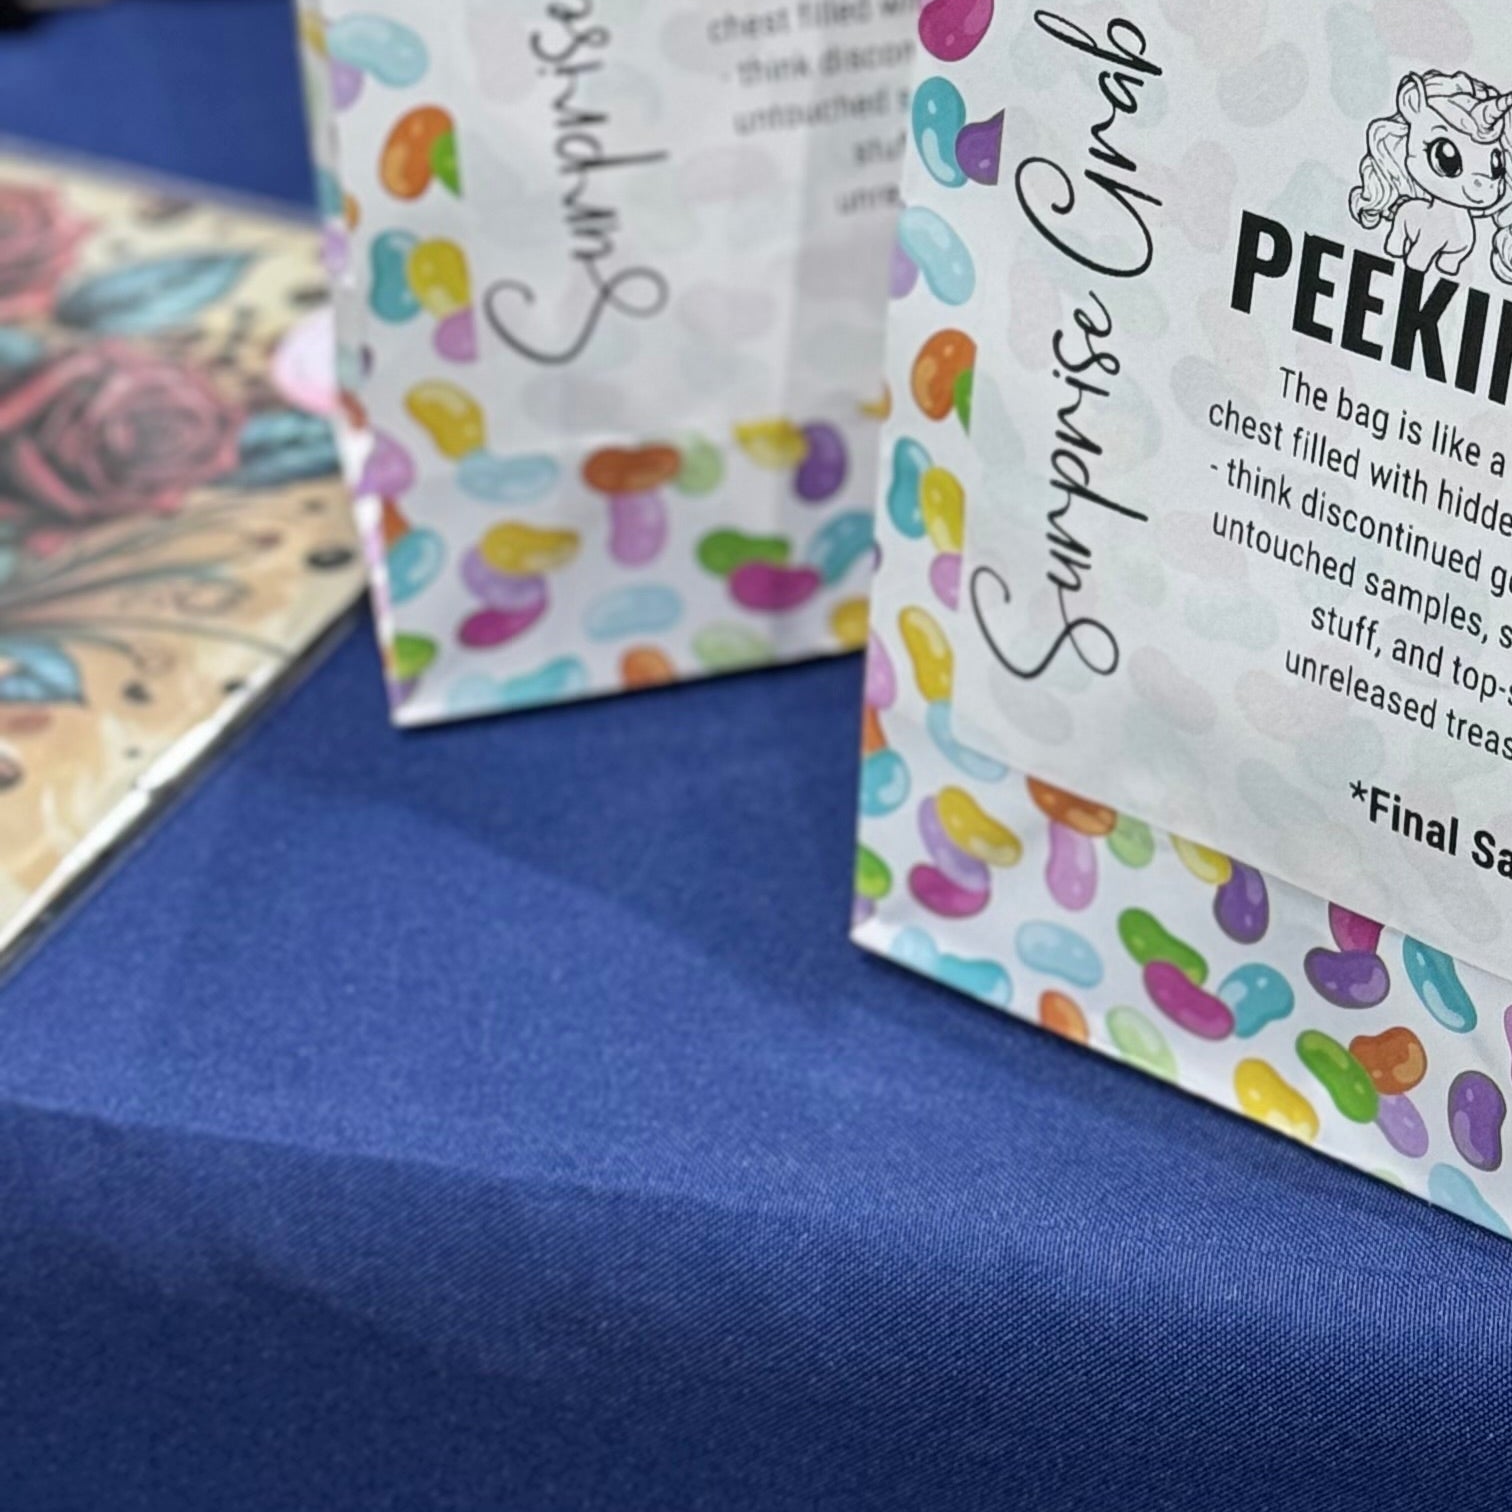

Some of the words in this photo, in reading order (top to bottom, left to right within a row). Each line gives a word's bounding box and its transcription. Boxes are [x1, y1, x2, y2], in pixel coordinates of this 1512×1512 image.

[1015, 8, 1165, 279] Grab
[1208, 399, 1284, 452] chest
[1292, 426, 1361, 481] filled
[1370, 461, 1429, 505] with
[1279, 366, 1328, 412] The
[1335, 386, 1390, 441] bag
[1398, 409, 1423, 446] is
[1431, 419, 1481, 468] like
[1489, 451, 1506, 479] a
[969, 290, 1149, 681] Surprise
[1226, 458, 1292, 510] think
[1301, 486, 1482, 582] discontinued
[1212, 511, 1357, 588] untouched
[1364, 571, 1488, 645] samples,
[1285, 649, 1438, 730] unreleased
[1310, 606, 1382, 659] stuff,
[1391, 638, 1445, 678] and
